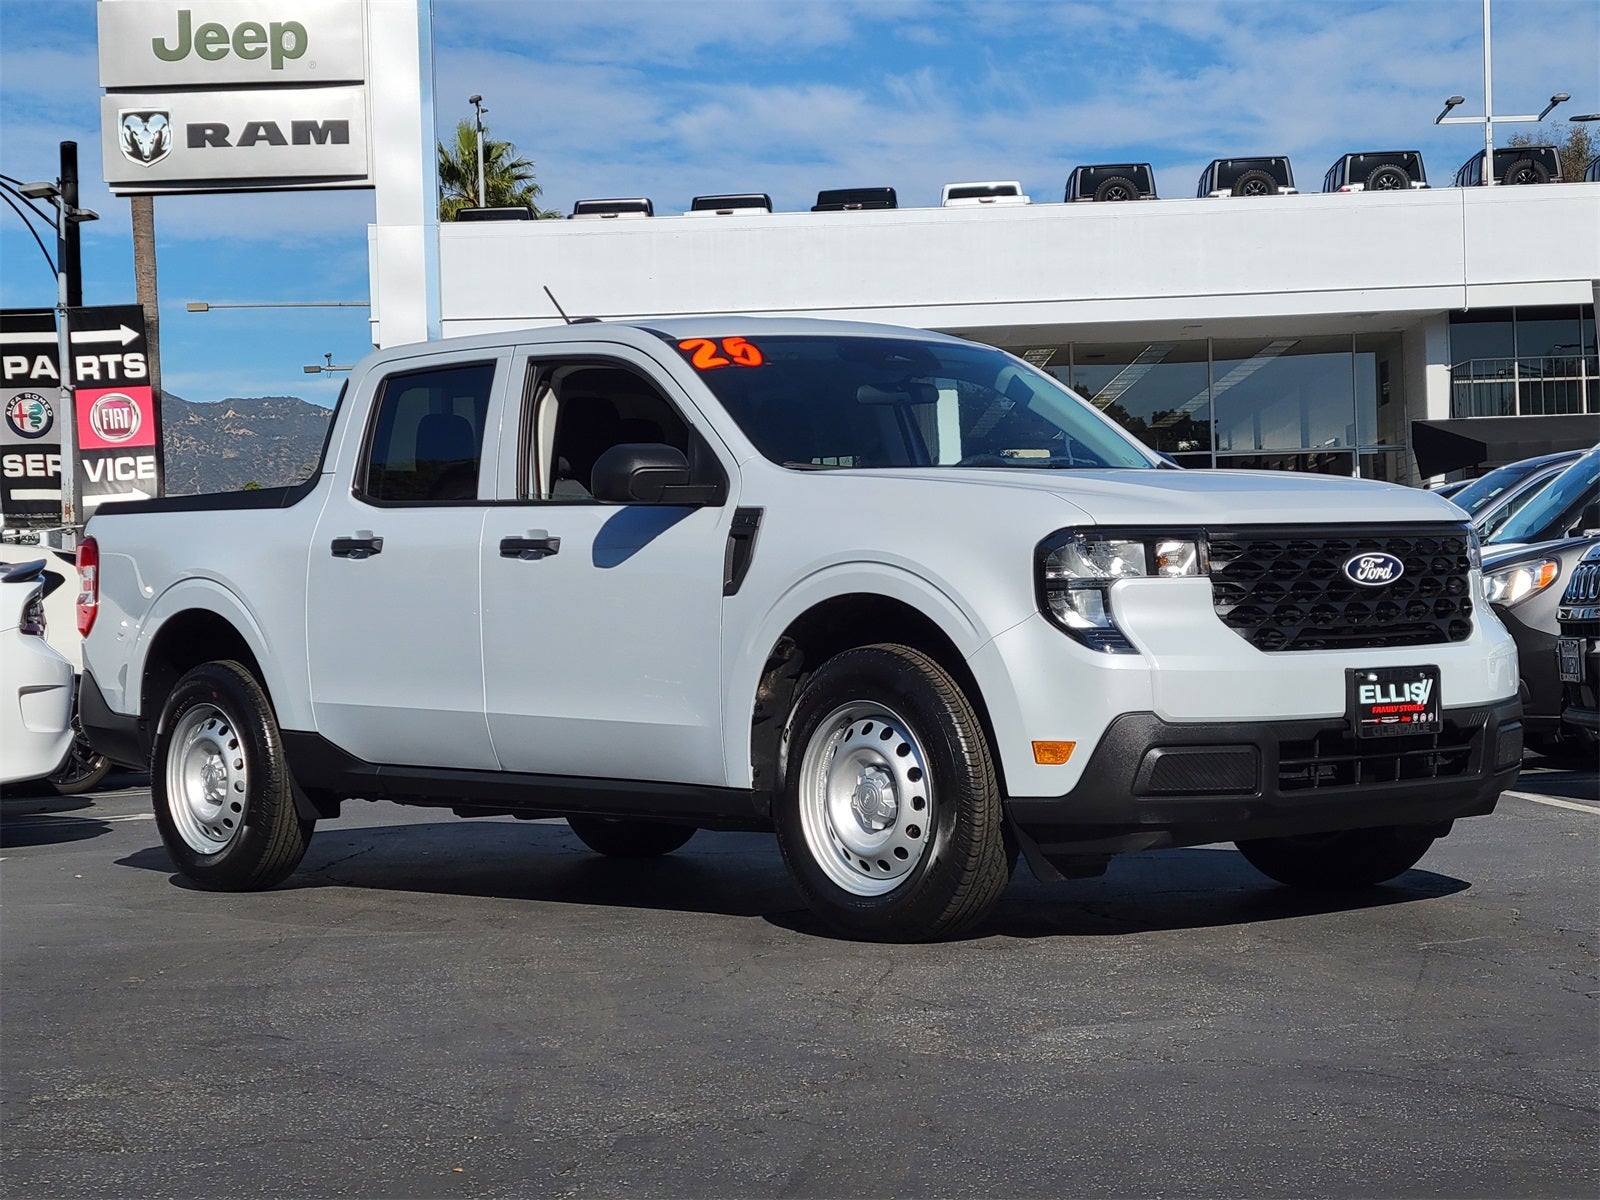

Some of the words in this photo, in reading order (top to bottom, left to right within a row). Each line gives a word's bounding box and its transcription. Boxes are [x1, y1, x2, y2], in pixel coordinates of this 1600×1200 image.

[152, 9, 308, 70] Jeep
[186, 119, 349, 149] RAM
[678, 336, 763, 370] 25
[6, 396, 22, 417] ALFA
[24, 393, 53, 417] ROMEO
[102, 407, 130, 430] FIAT
[1357, 557, 1394, 580] Ford
[1372, 705, 1399, 713] FAMILY
[1399, 704, 1425, 712] STORES
